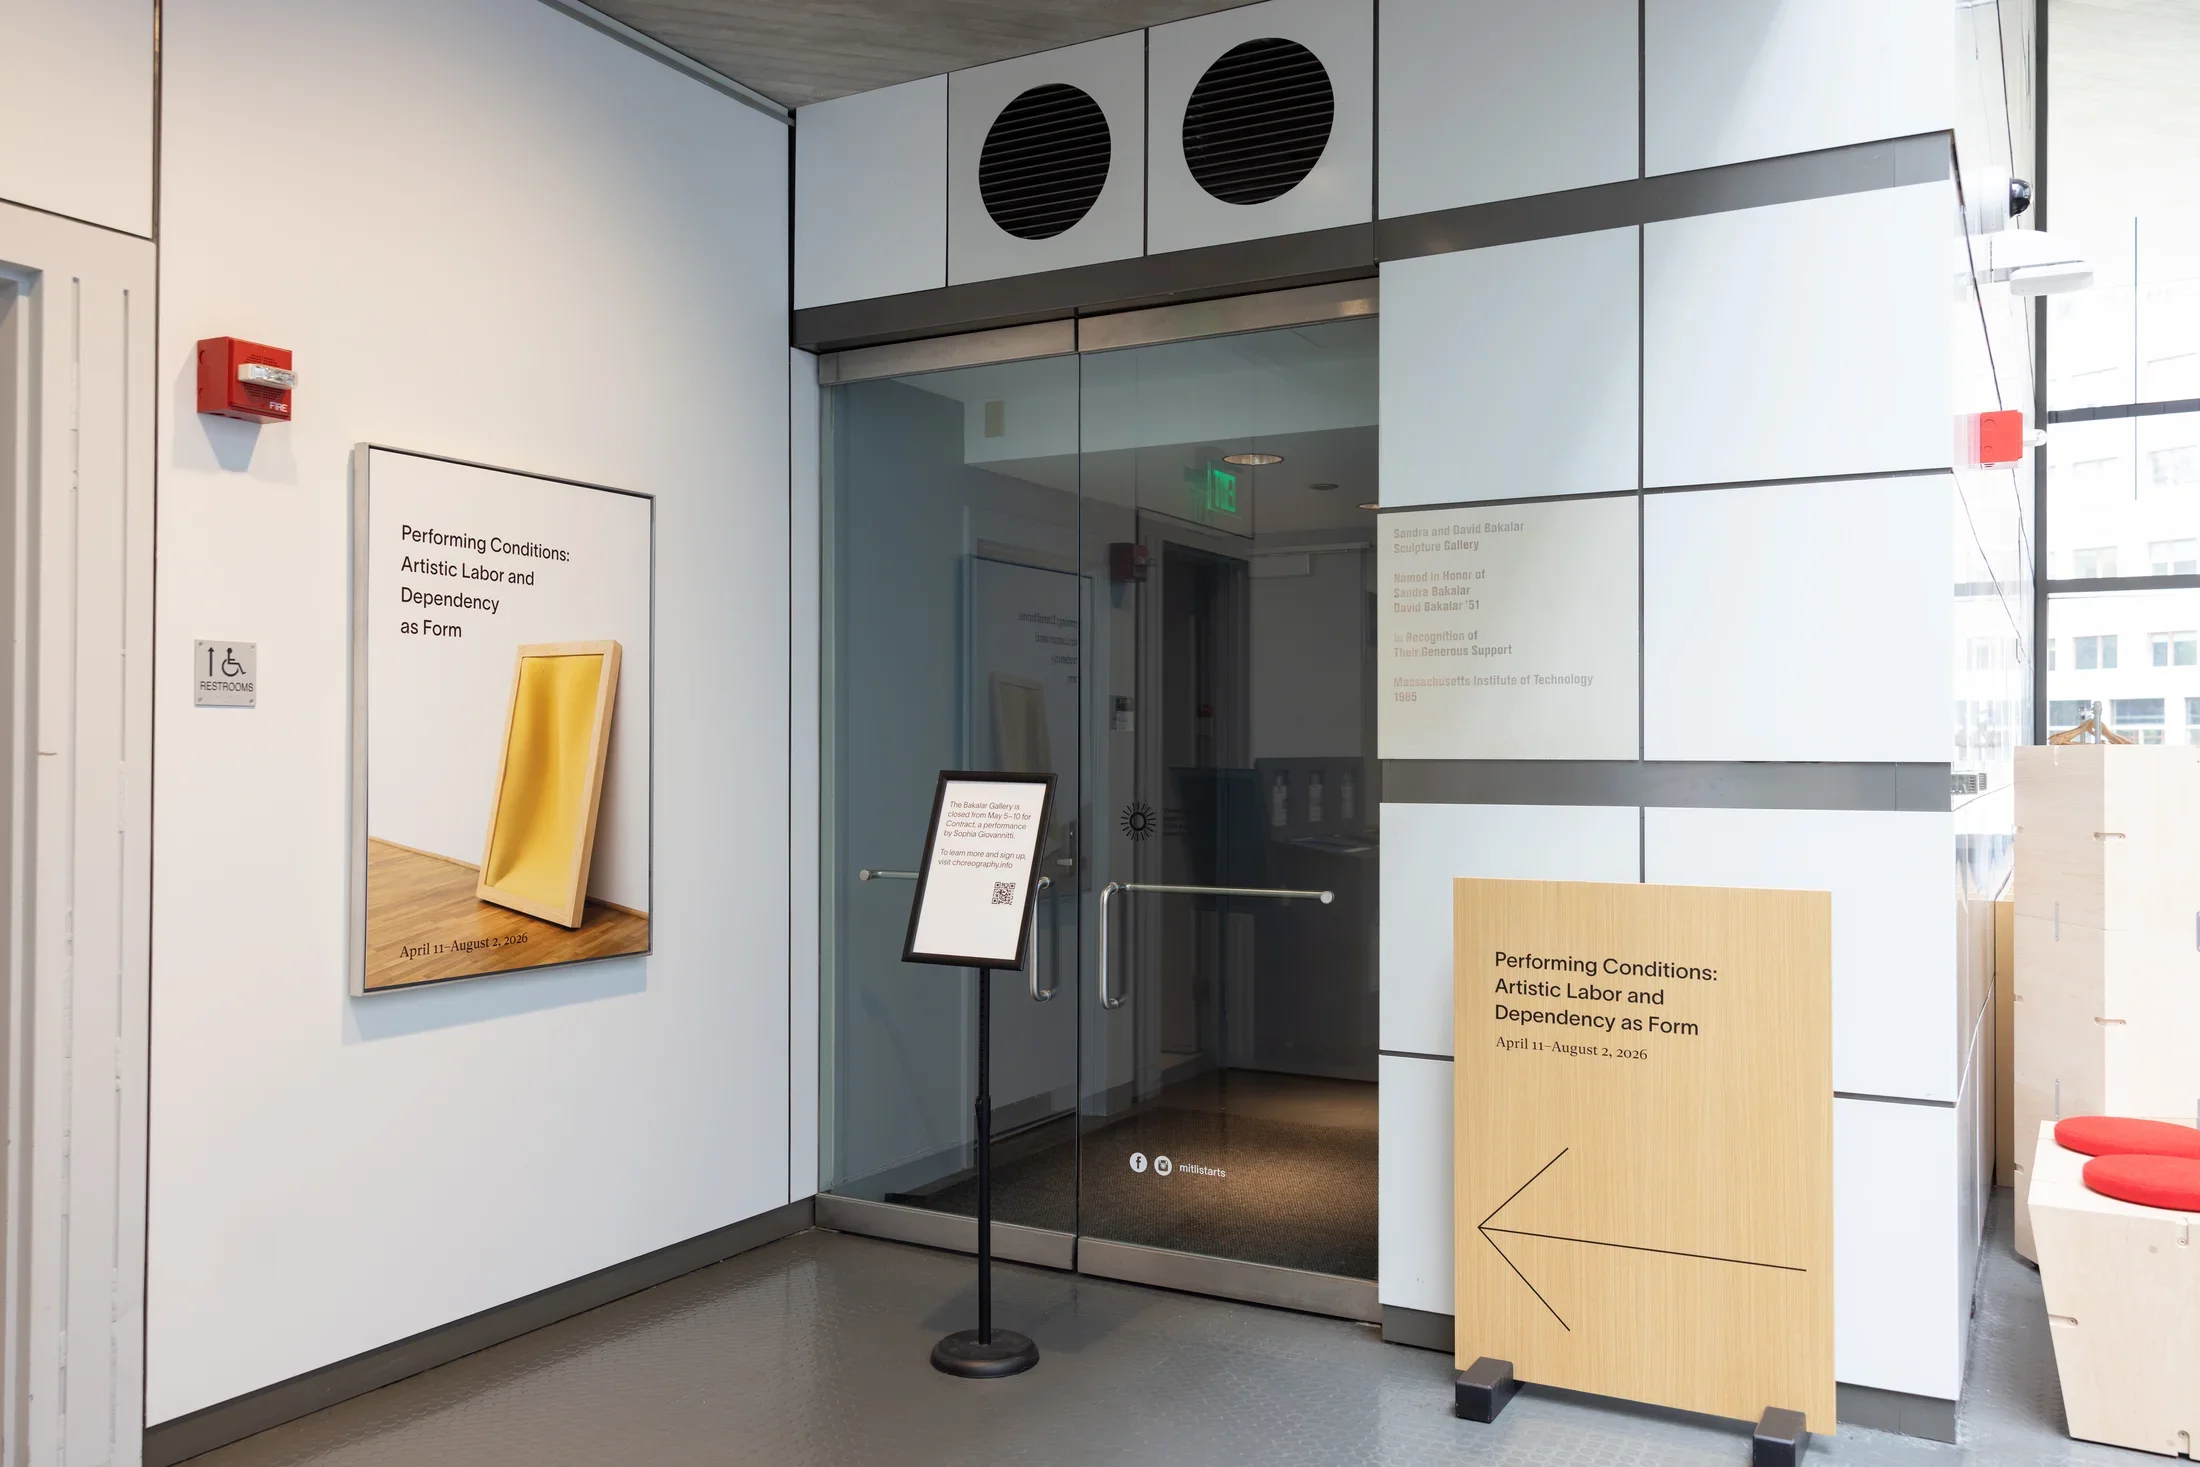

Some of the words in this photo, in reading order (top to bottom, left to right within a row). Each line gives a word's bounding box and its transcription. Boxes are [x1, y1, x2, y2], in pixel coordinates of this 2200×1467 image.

[269, 402, 287, 411] FIRE
[1394, 528, 1428, 538] Sandra
[1432, 525, 1450, 536] and
[1453, 524, 1481, 535] David
[1485, 521, 1524, 533] Bakalar
[402, 525, 486, 554] Performing
[491, 537, 569, 561] Conditions:
[1394, 542, 1440, 554] Sculpture
[1444, 540, 1479, 551] Gallery
[401, 556, 457, 577] Artistic
[463, 563, 504, 582] Labor
[508, 571, 534, 585] and
[1394, 572, 1427, 583] Named
[1431, 572, 1439, 581] in
[1443, 570, 1472, 580] Honor
[1476, 569, 1485, 579] of
[1394, 588, 1428, 598] Sandra
[1432, 585, 1470, 596] Bakalar
[402, 587, 499, 614] Dependency
[1394, 602, 1420, 613] David
[1424, 601, 1463, 611] Bakalar
[401, 622, 418, 634] as
[424, 620, 461, 637] Form
[1406, 631, 1464, 644] Recognition
[1468, 630, 1478, 640] of
[1394, 648, 1420, 657] Their
[1422, 647, 1468, 656] Generous
[1472, 645, 1512, 657] Support
[200, 681, 254, 692] RESTROOMS
[1394, 676, 1472, 687] Massachusetts
[1474, 675, 1517, 685] Institute
[1520, 675, 1531, 685] of
[1534, 674, 1593, 687] Technology
[1394, 692, 1417, 702] 1985
[963, 801, 988, 809] Bakalar
[989, 802, 1013, 811] Gallery
[988, 812, 1002, 820] May
[946, 820, 976, 828] Contract,
[944, 830, 952, 838] by
[954, 830, 976, 838] Sophia
[978, 831, 1015, 839] Giovannitti.
[952, 859, 1013, 869] choreography.info
[400, 943, 429, 960] April
[492, 938, 501, 948] 2,
[504, 932, 528, 946] 2026
[1496, 952, 1597, 976] Performing
[1603, 958, 1717, 981] Conditions:
[1495, 978, 1561, 997] Artistic
[1567, 983, 1622, 1001] Labor
[1628, 989, 1663, 1005] and
[1496, 1005, 1615, 1032] Dependency
[1621, 1018, 1642, 1031] as
[1649, 1016, 1698, 1035] Form
[1496, 1037, 1528, 1051] April
[1602, 1048, 1612, 1059] 2,
[1617, 1049, 1647, 1060] 2026
[1180, 1164, 1225, 1177] mitlistarts
